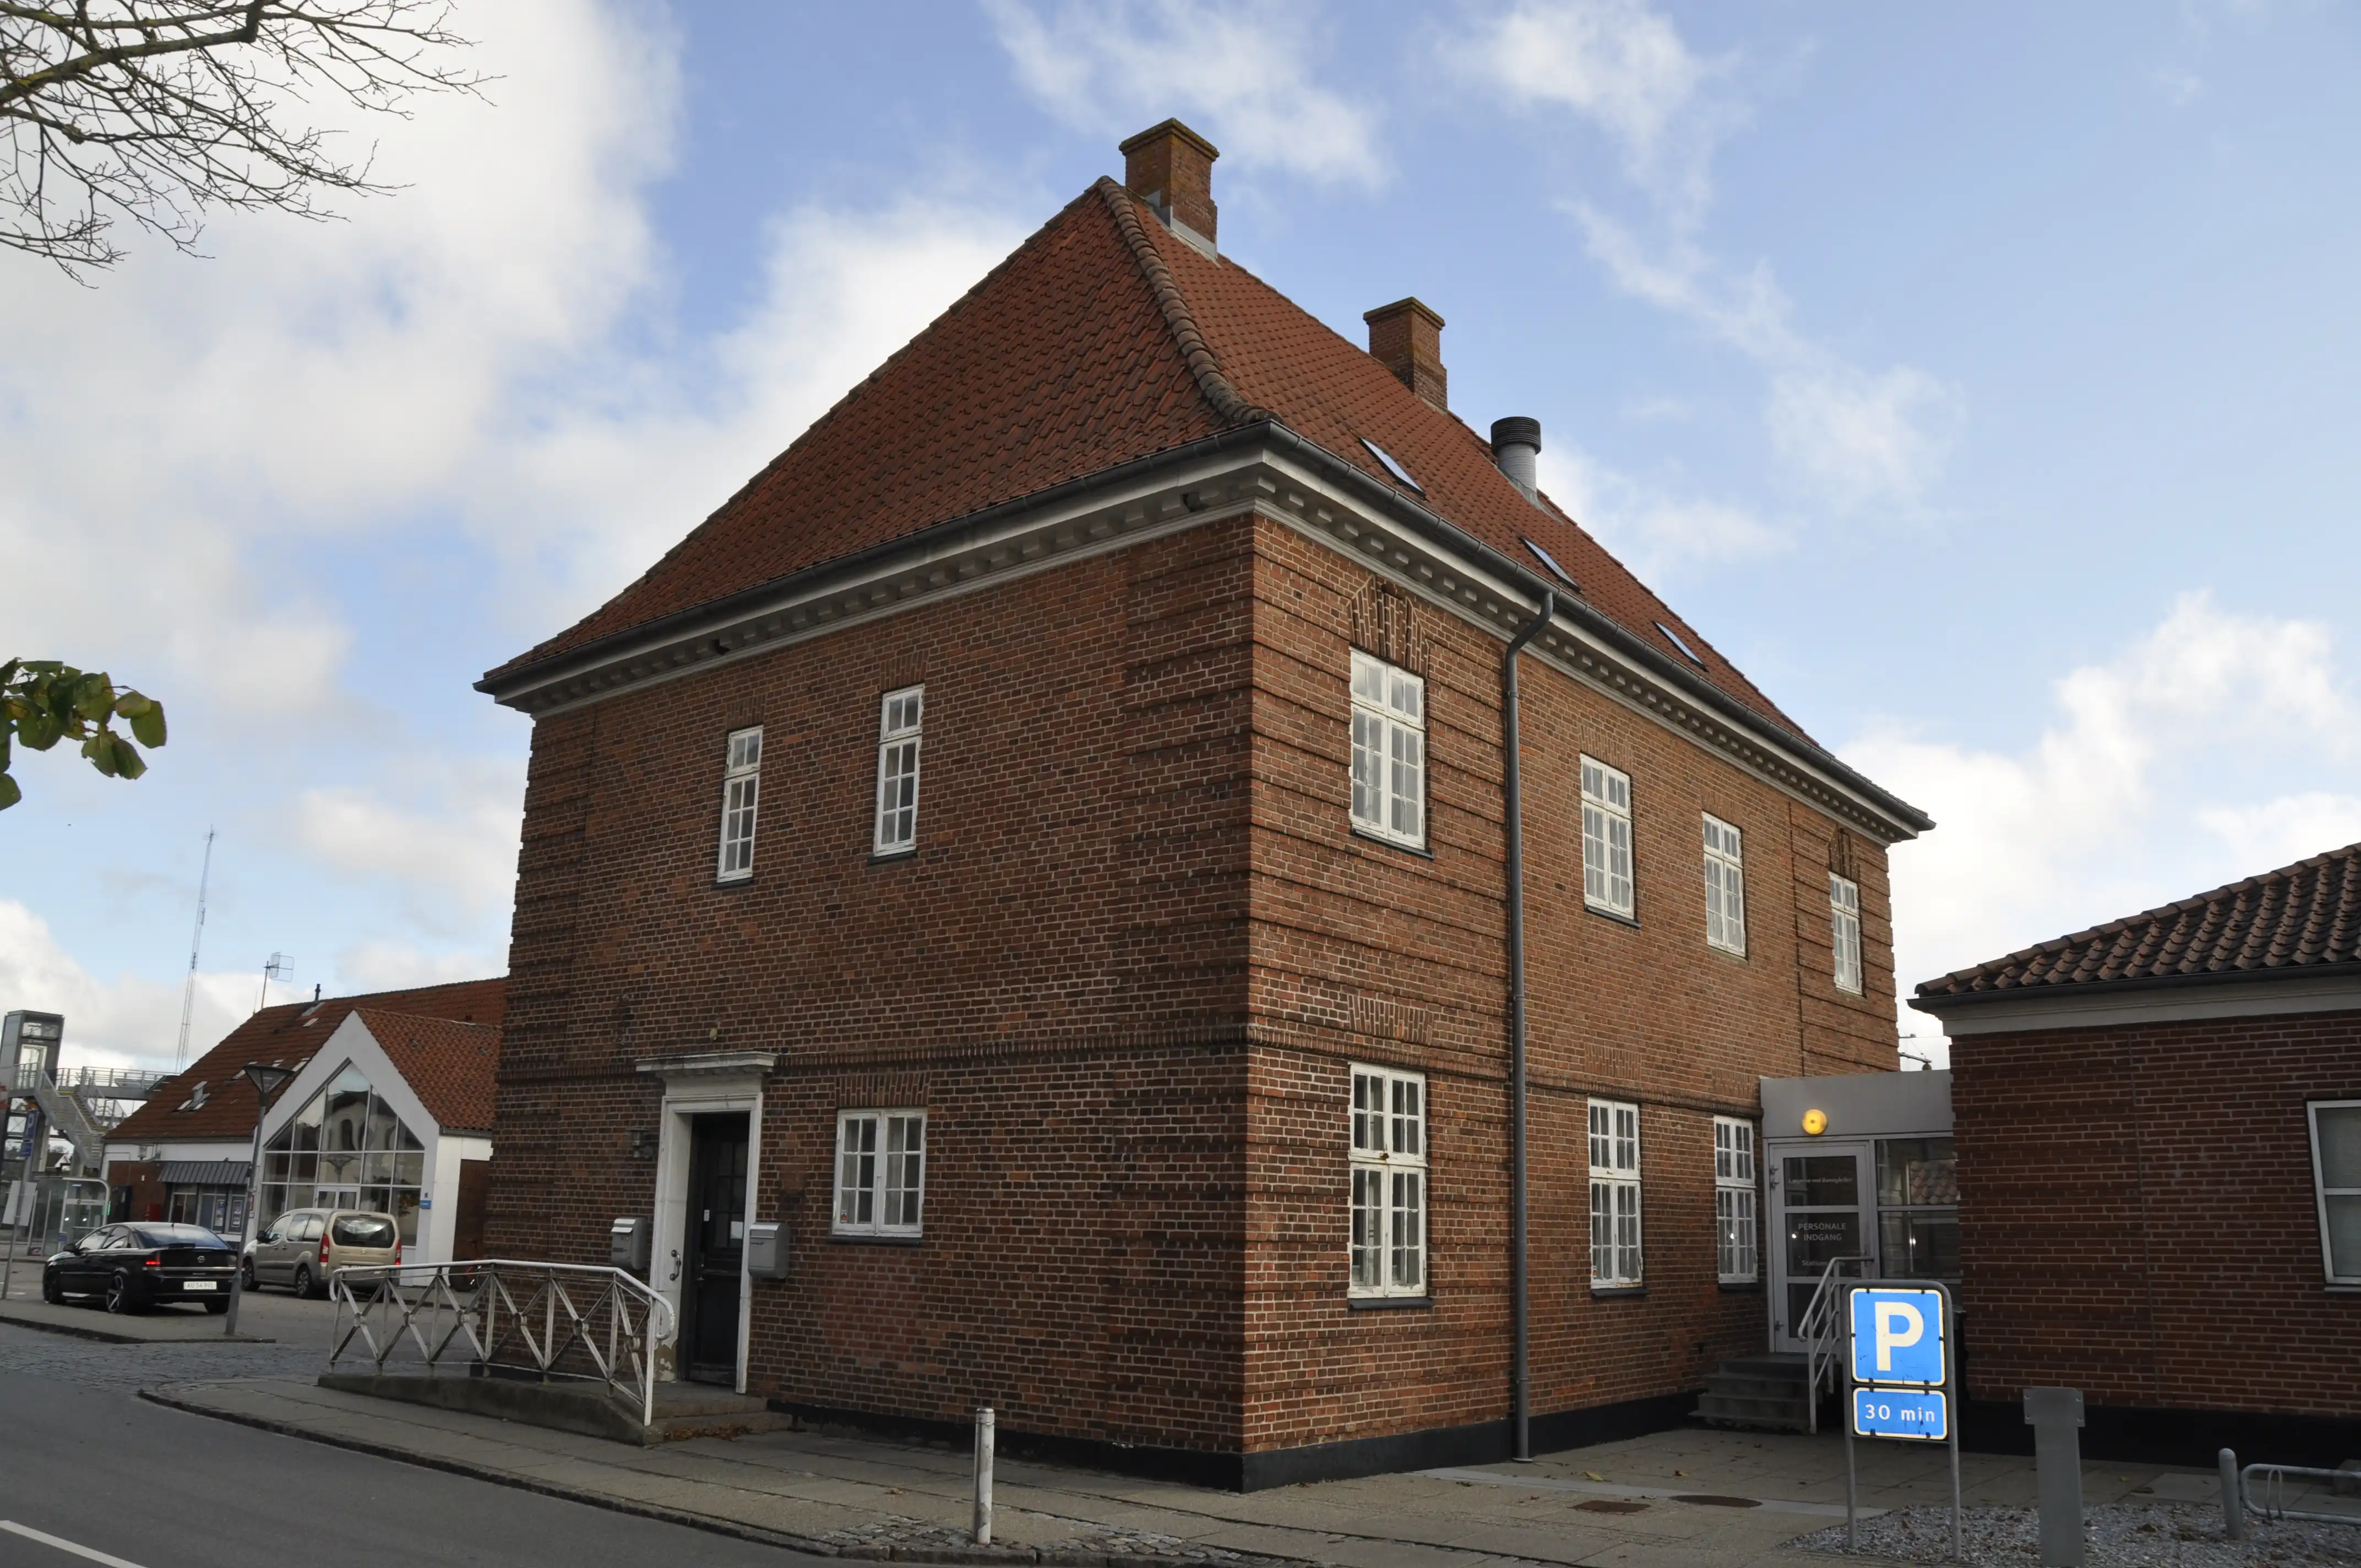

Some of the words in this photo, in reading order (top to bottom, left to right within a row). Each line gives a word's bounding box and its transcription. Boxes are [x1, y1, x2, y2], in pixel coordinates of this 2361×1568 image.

[1798, 1222, 1847, 1231] PERSONALE
[1874, 1301, 1924, 1371] P
[1865, 1404, 1891, 1420] 30
[1901, 1407, 1935, 1422] min
